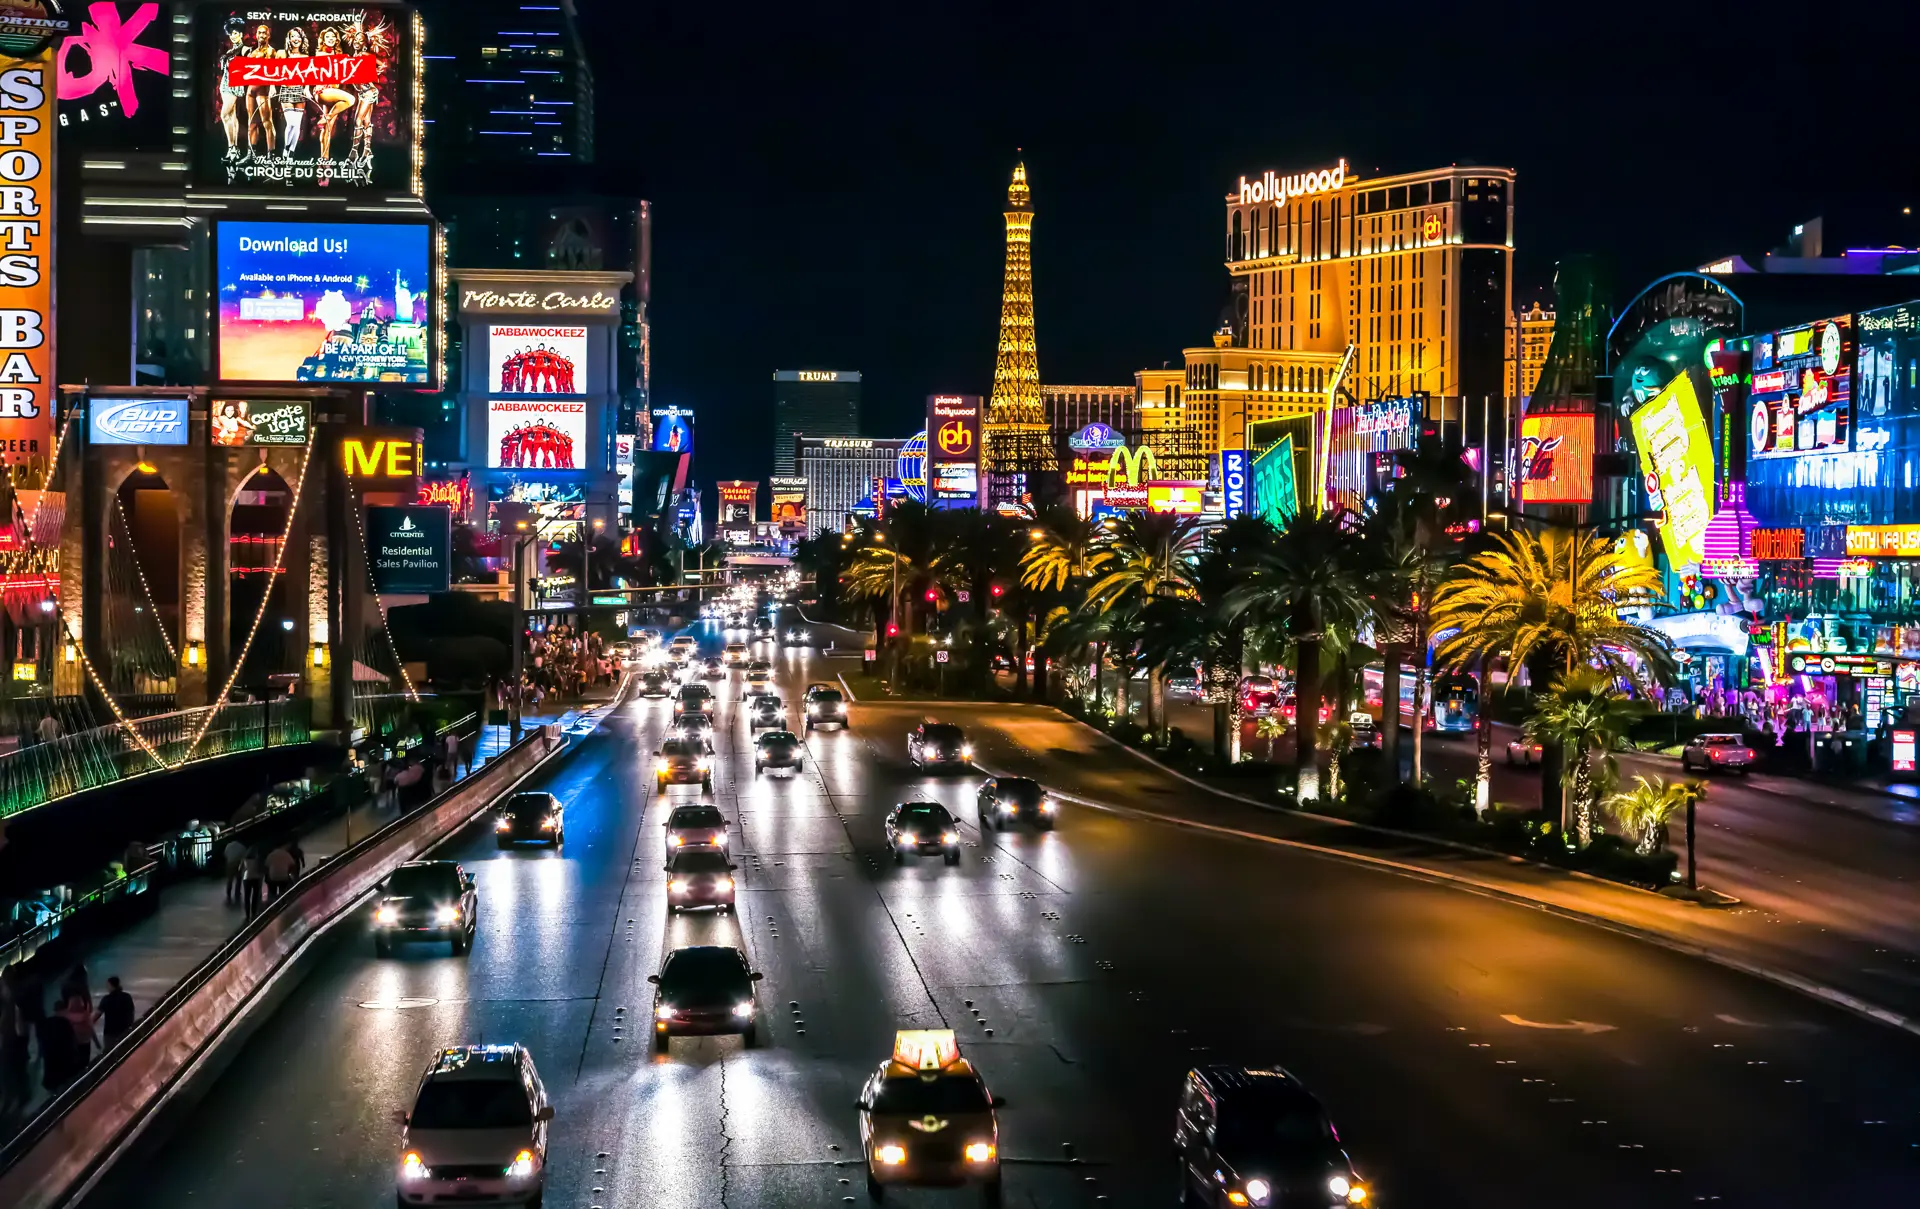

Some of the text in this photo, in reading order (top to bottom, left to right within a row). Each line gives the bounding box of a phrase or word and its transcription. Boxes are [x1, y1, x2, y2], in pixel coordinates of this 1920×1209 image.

[247, 12, 362, 22] SEXY FUN ACROBATIC
[243, 57, 363, 83] ZUMANITY
[255, 155, 350, 169] The Sensual Side of
[0, 68, 45, 289] SPORTS
[245, 167, 292, 180] CIRQUE
[295, 168, 313, 178] DU
[1240, 159, 1345, 208] hollywood
[240, 237, 348, 253] Download Us!
[240, 273, 274, 281] Available
[287, 274, 313, 282] iPhone
[314, 274, 321, 282] &
[541, 291, 615, 310] Carlo
[492, 327, 585, 338] JABBAWOCKEEZ
[325, 343, 339, 354] BE
[340, 344, 350, 354] A
[351, 344, 377, 354] PART
[379, 344, 395, 355] OF
[0, 308, 44, 418] BAR
[799, 371, 837, 380] TRUMP
[491, 402, 584, 413] JABBAWOCKEEZ
[935, 396, 962, 406] planet
[120, 408, 178, 421] BUD
[251, 405, 304, 425] coyote
[935, 407, 976, 417] hollywood
[110, 420, 181, 433] LIGHT
[267, 416, 306, 433] ugly
[942, 421, 972, 450] ph
[824, 439, 873, 447] TREASURE
[780, 477, 808, 485] MIRAGE
[1751, 529, 1772, 559] FOOD
[1774, 529, 1802, 558] COURT
[382, 546, 433, 556] Residential
[376, 559, 439, 569] Sales Pavilion
